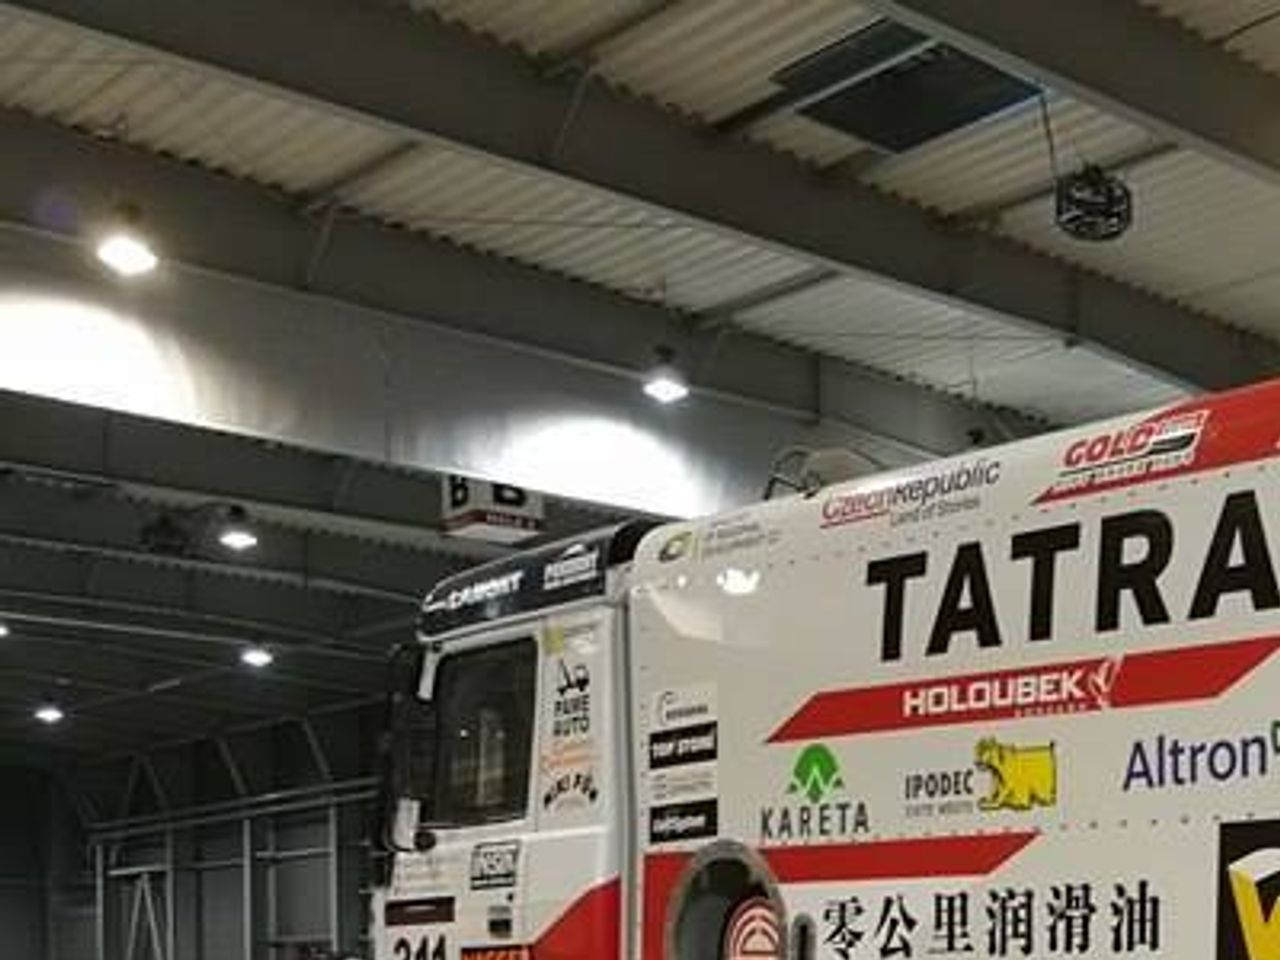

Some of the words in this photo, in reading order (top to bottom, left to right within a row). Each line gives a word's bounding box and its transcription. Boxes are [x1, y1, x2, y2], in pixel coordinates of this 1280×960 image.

[903, 669, 1087, 718] HOLOUBEK
[1123, 733, 1267, 791] Altron
[905, 769, 974, 800] IPODEC
[761, 802, 870, 840] KARETA
